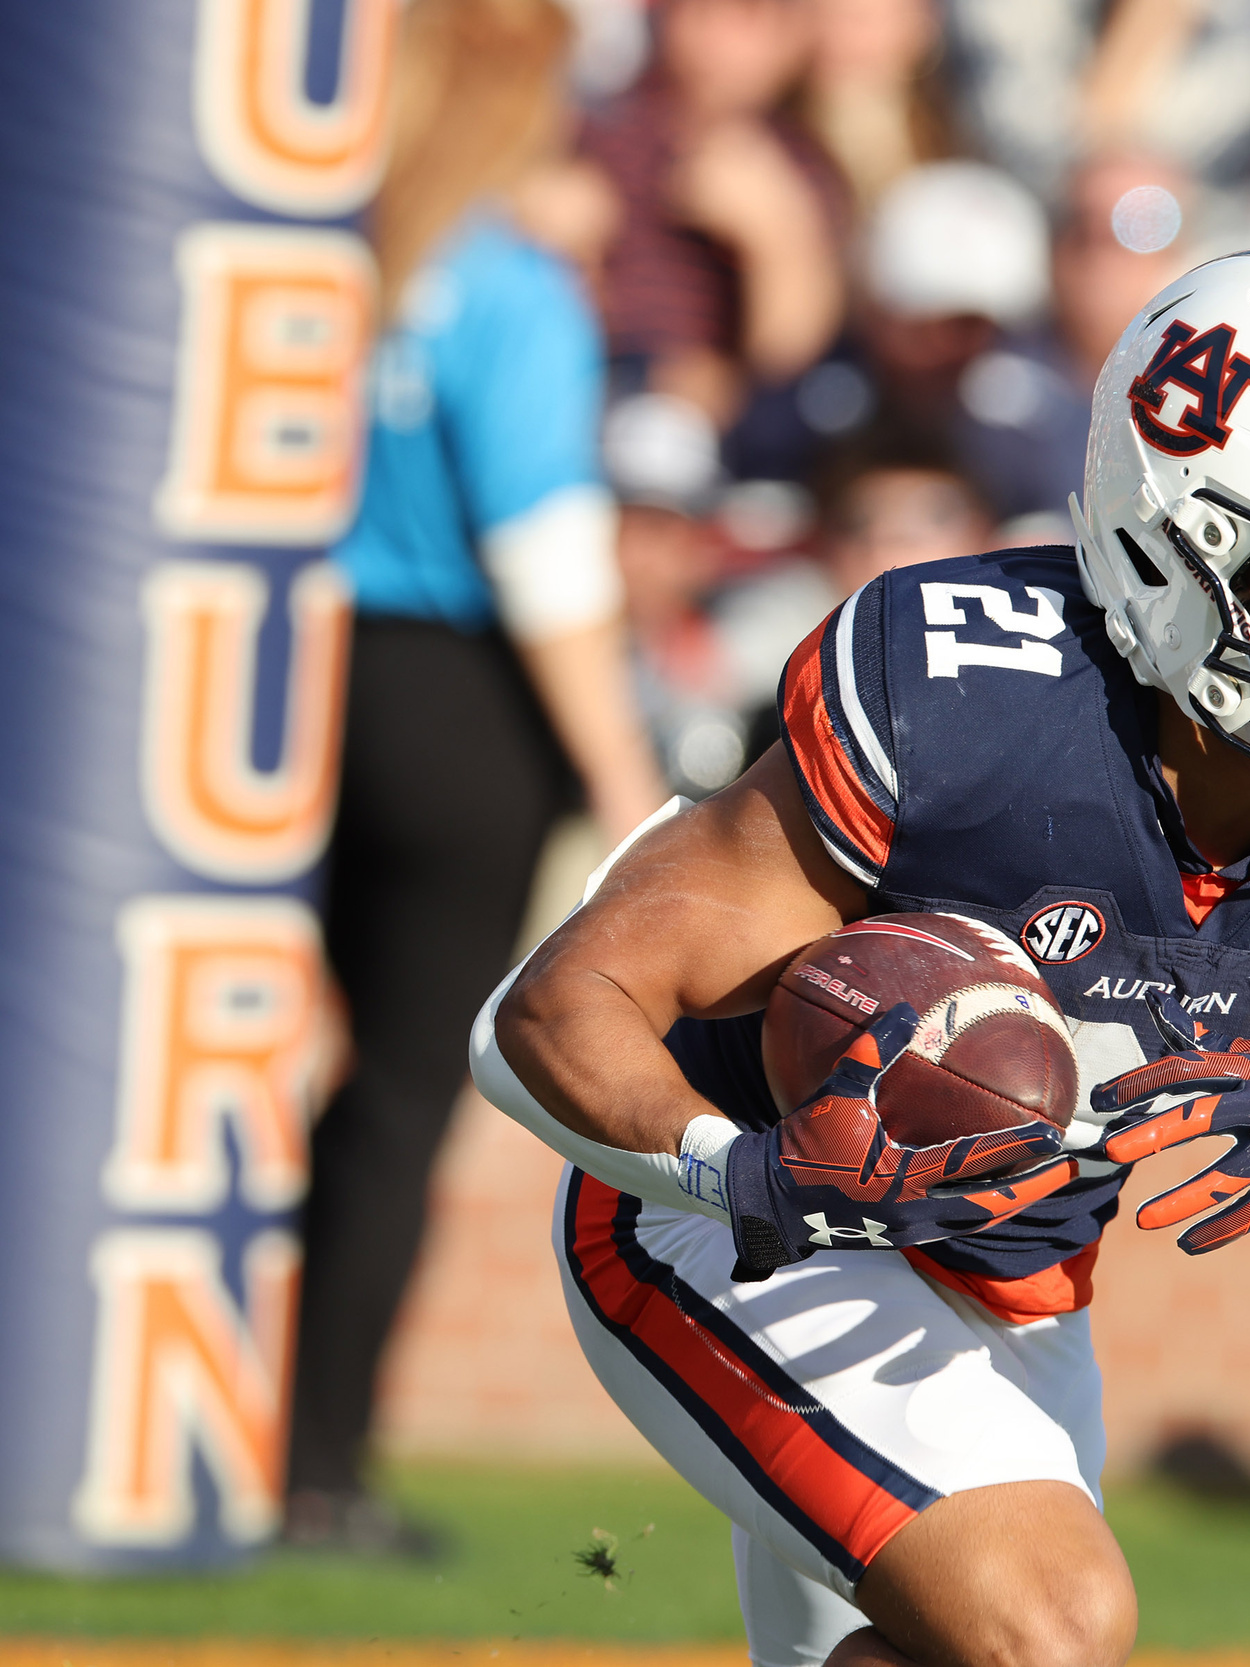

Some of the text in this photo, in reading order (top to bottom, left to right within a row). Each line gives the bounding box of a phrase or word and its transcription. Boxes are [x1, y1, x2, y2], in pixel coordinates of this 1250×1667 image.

[919, 582, 1066, 679] 21
[1027, 907, 1099, 961] SEC
[825, 978, 880, 1015] ELITE
